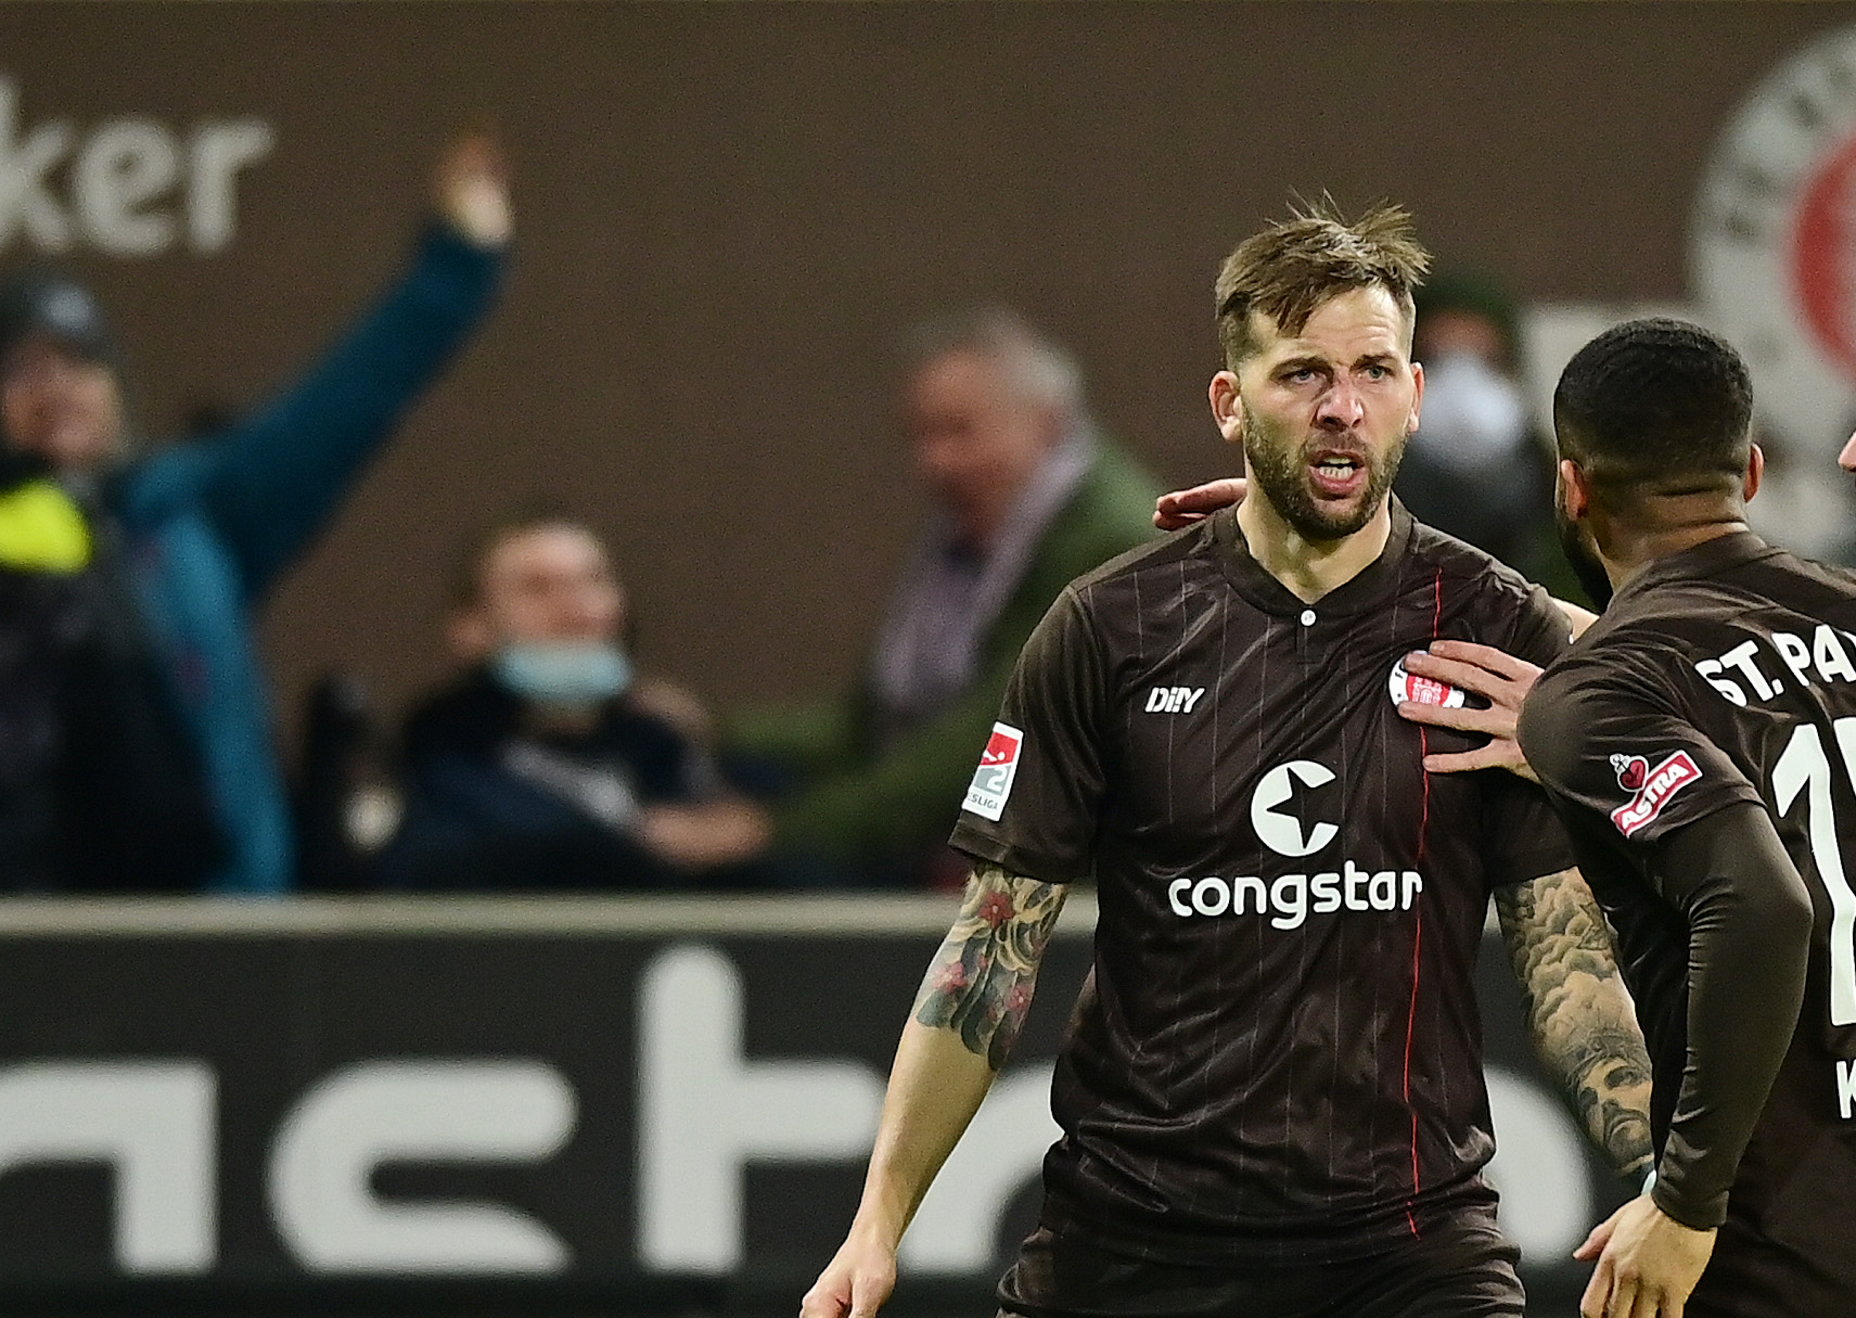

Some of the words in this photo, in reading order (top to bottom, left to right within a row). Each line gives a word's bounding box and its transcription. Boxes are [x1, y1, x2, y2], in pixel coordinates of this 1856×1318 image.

[1694, 641, 1783, 707] ST.
[1621, 763, 1689, 830] ASTRA
[1168, 861, 1422, 930] congstar
